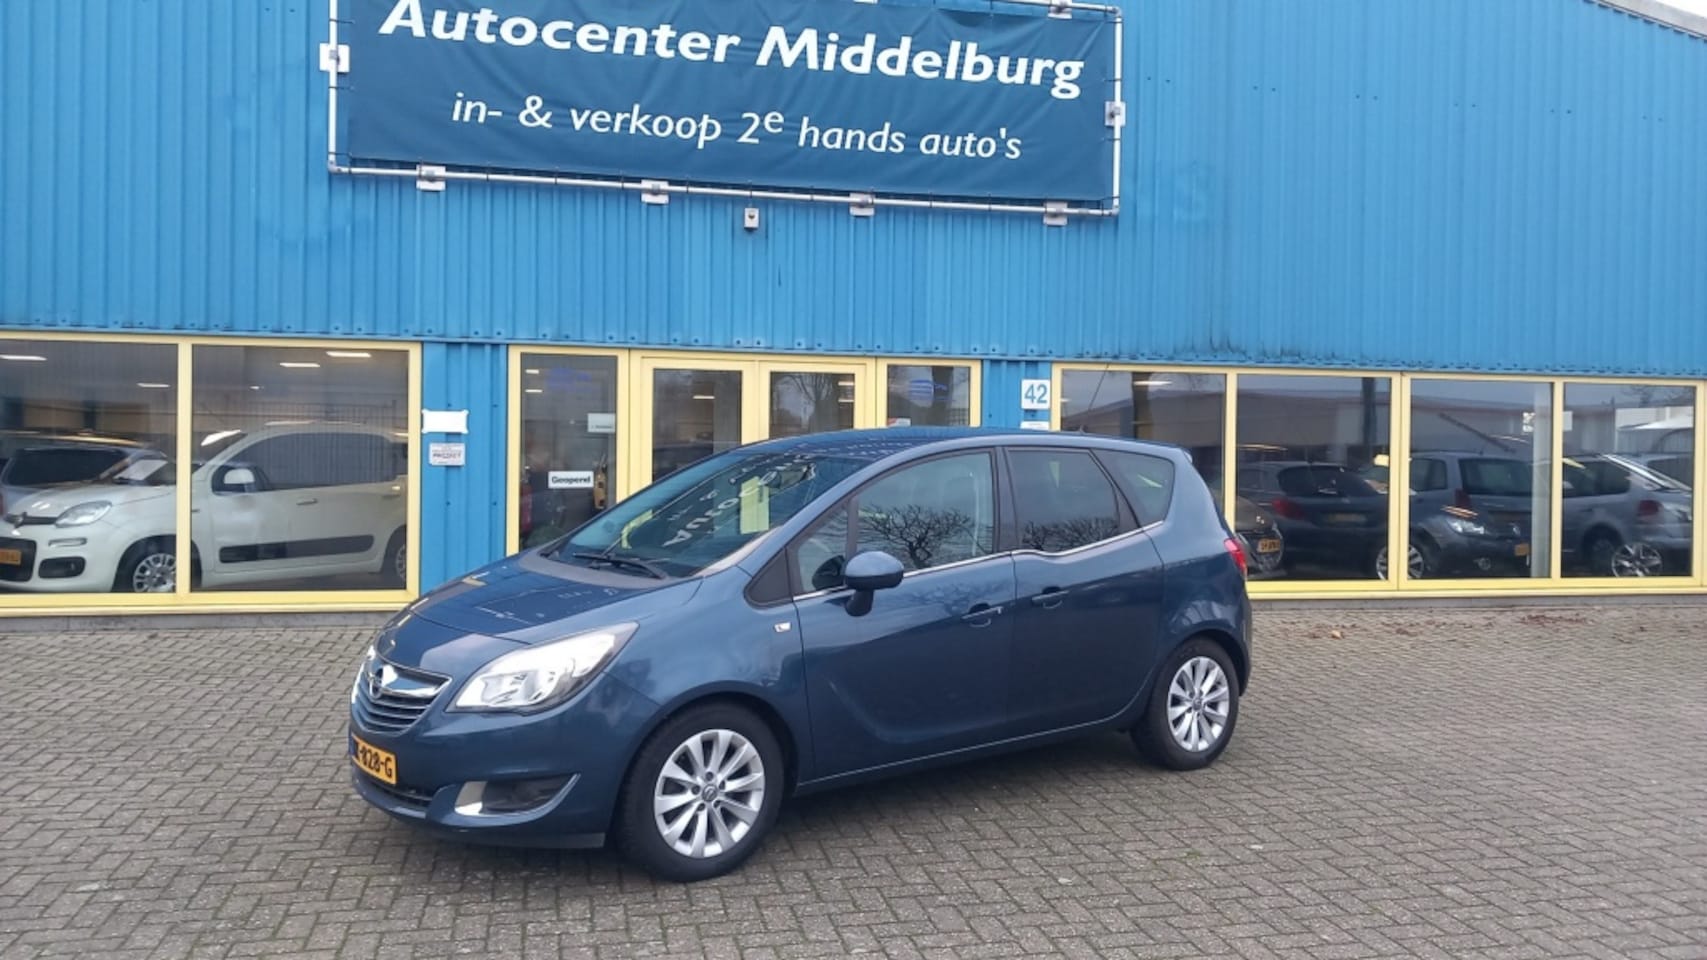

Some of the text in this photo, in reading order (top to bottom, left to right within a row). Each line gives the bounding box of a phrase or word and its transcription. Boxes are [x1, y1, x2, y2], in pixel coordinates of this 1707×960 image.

[377, 0, 1084, 99] Autocenter Middelburg
[452, 92, 502, 123] in-
[518, 95, 552, 128] &
[570, 104, 721, 149] verkoop
[798, 116, 906, 153] hands
[919, 127, 1022, 160] auto's
[1024, 383, 1048, 404] 42
